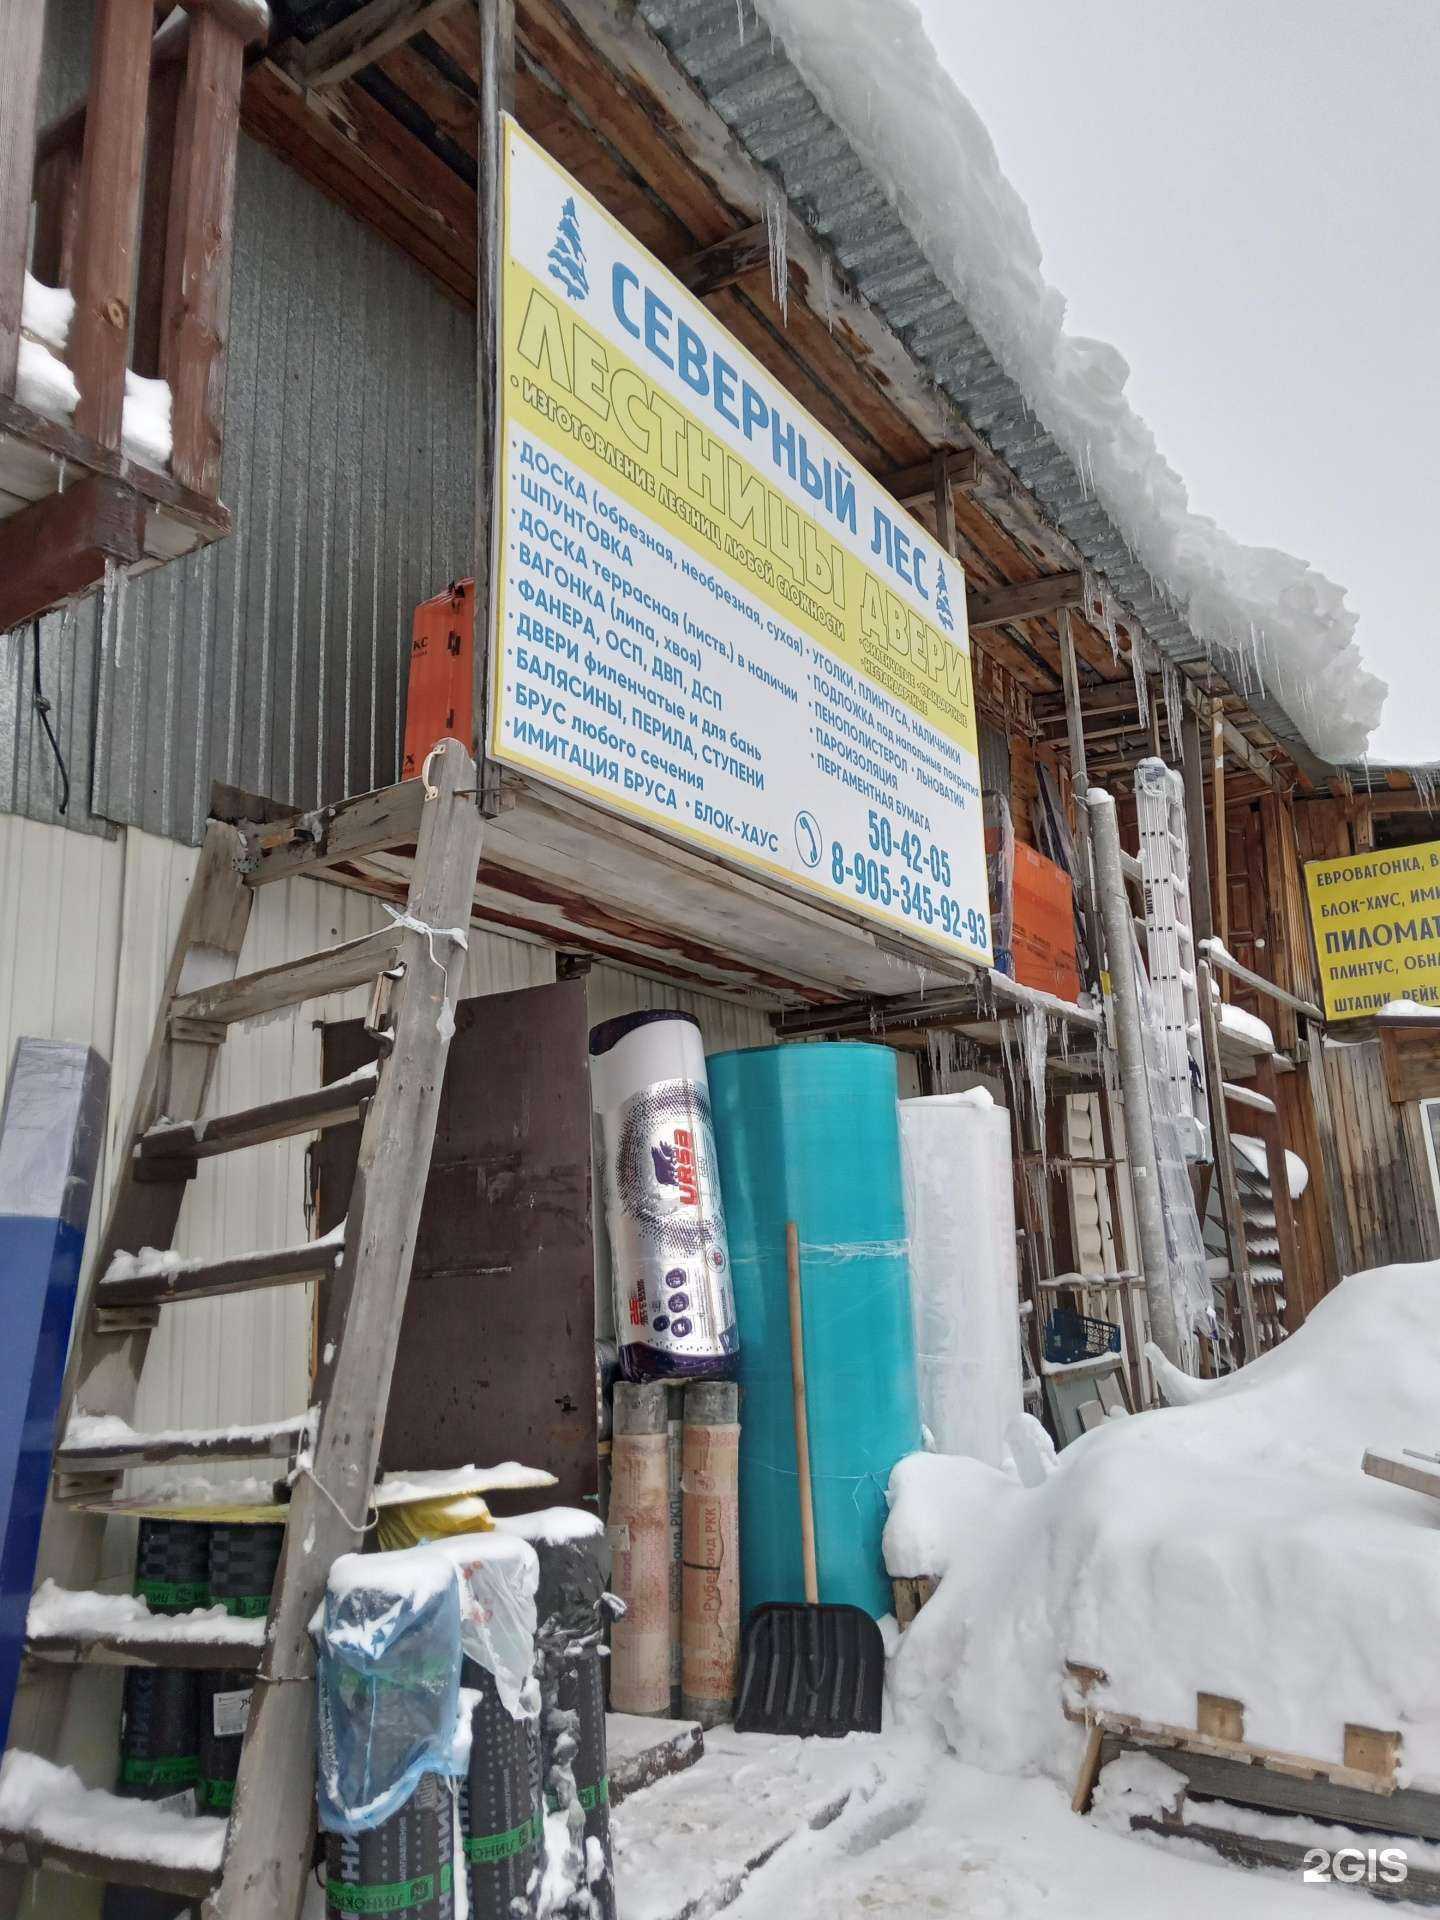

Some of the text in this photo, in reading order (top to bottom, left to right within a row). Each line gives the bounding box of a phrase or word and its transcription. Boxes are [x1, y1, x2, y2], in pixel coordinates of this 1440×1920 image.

[611, 261, 930, 600] СЕВЕРНЫЙ ЛЕС
[517, 288, 969, 707] ЛЕСТНИЦЫ ДВЕРИ
[520, 473, 634, 567] ШПУНТОВКА
[520, 440, 803, 657] ДОСКА (обрезная, необрезная, сухая)
[522, 376, 846, 642] ИЗГОТОВЛЕНИЕ ЛЕСТНИЦ ЛЮБОЙ СЛОЖНОСТИ
[518, 578, 723, 711] ФАНЕРА, ОСП, ДВП, ДСП
[519, 508, 798, 703] ДОСКА террасная (листв.) в наличии
[519, 541, 702, 673] ВАГОНКА (липа, хвоя)
[515, 682, 704, 791] БРУС любого сечения
[516, 611, 762, 761] ДВЕРИ филенчатые и для бань
[516, 646, 765, 791] БАЛЯСИНЫ, ПЕРИЛА, СТУПЕНИ
[812, 648, 961, 765] УГОЛКИ, ПЛИНТУСА, НАЛИЧНИКИ
[813, 674, 980, 797] ПОДЛОЖКА под напольные покрытия
[513, 716, 677, 809] ИМИТАЦИЯ БРУСА
[814, 701, 966, 809] ПЕНОПОЛИСТЕРОЛ ЛЬНОВАТИН
[815, 726, 899, 790] ПАРОИЗОЛЯЦИЯ
[817, 752, 931, 833] ПЕРГАМЕНТНАЯ БУМАГА
[694, 799, 779, 852] БЛОК-ХАУС
[868, 809, 951, 888] 50-42-05
[1317, 856, 1424, 887] ЕВРОВАГОНКА,
[831, 840, 987, 949] 8-905-345-92-93
[1321, 892, 1405, 918] БЛОК-ХАУС,
[1330, 959, 1399, 981] ПЛИНТУС,
[704, 1507, 717, 1533] РКК
